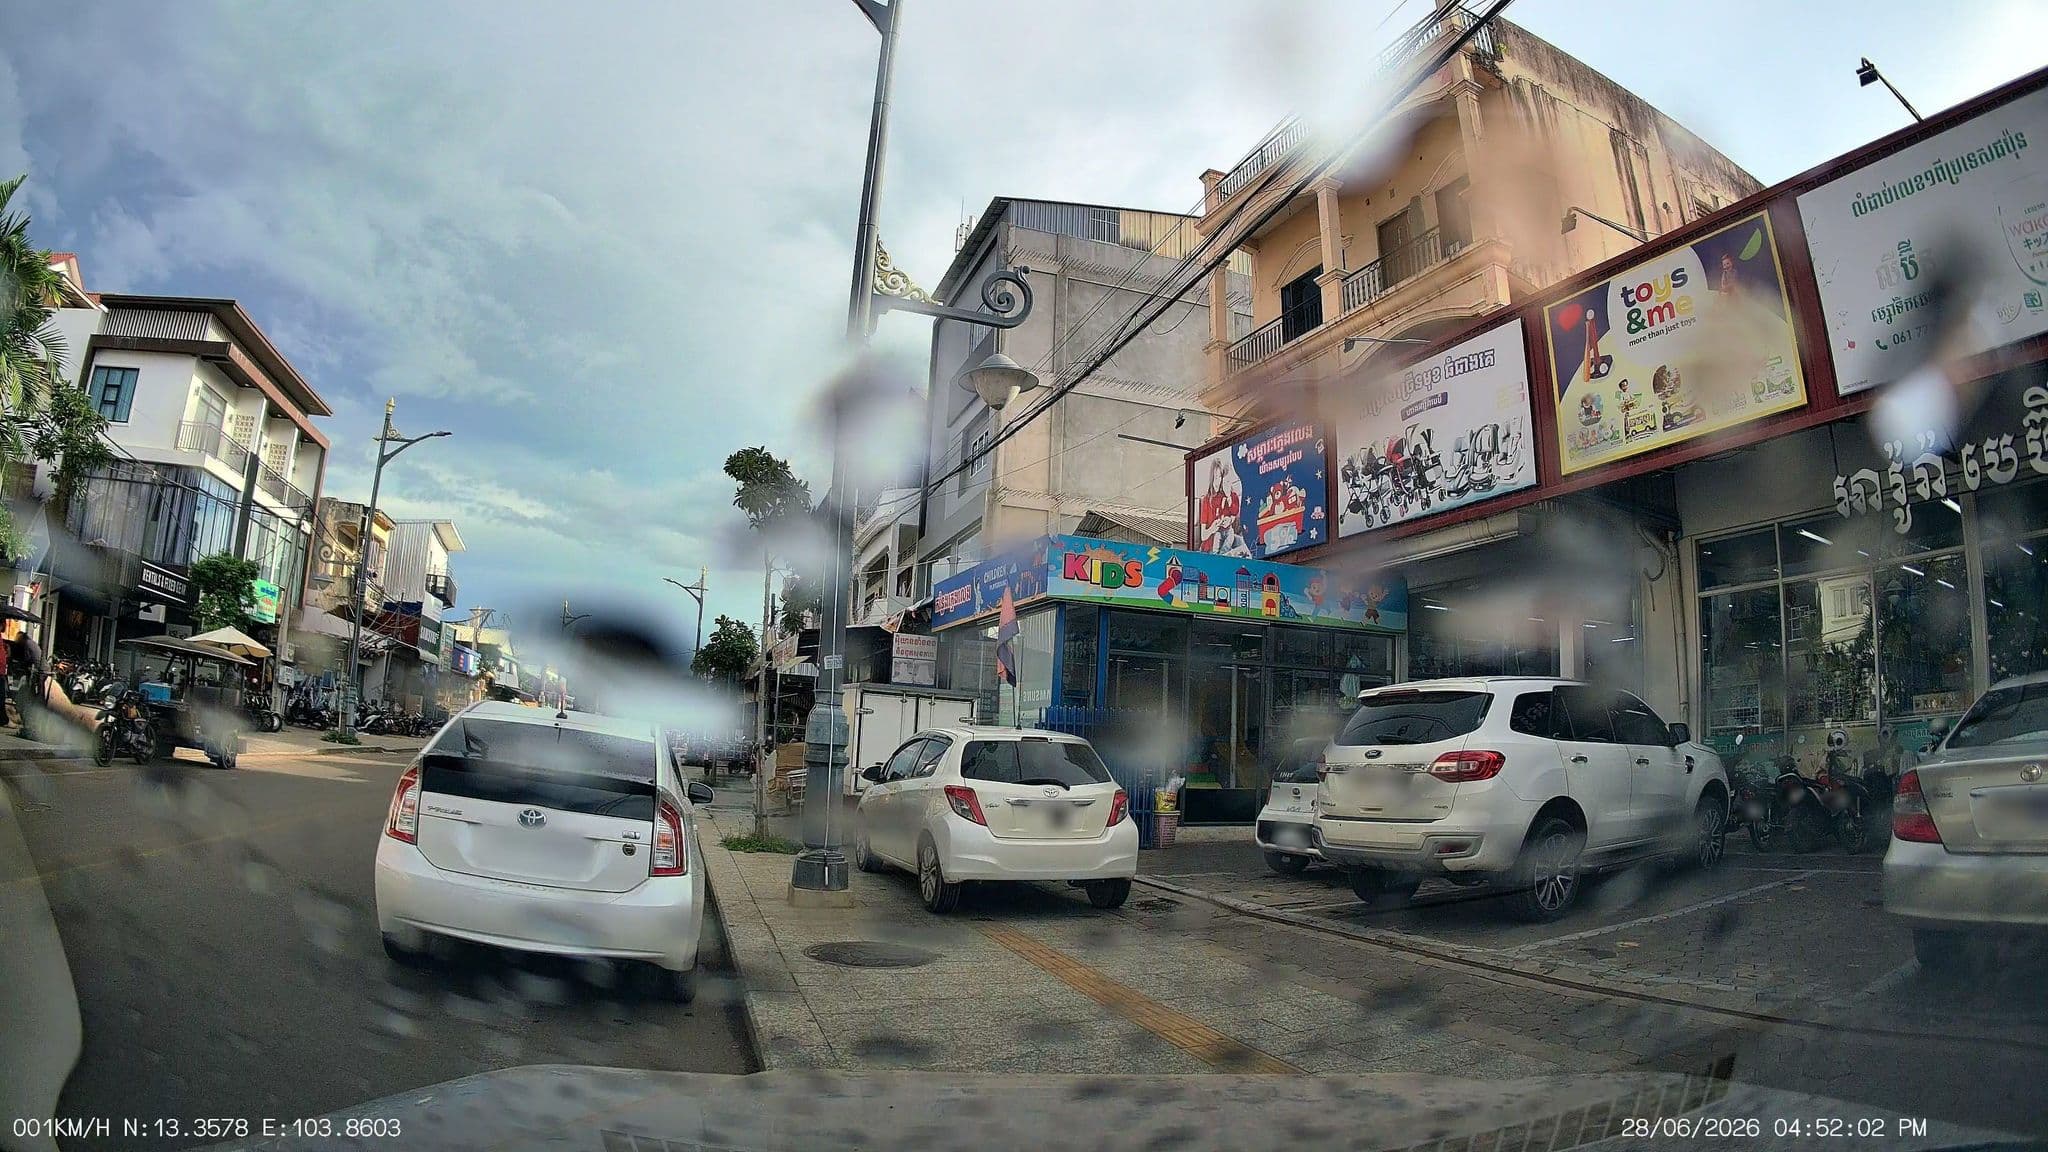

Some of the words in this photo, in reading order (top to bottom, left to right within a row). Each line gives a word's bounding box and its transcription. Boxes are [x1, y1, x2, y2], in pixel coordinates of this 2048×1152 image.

[1620, 267, 1689, 308] toys
[1629, 335, 1647, 347] more
[1648, 328, 1665, 340] than
[1664, 322, 1680, 336] just
[1680, 316, 1697, 328] toys
[1892, 329, 1912, 345] 061
[1063, 552, 1143, 589] KIDS
